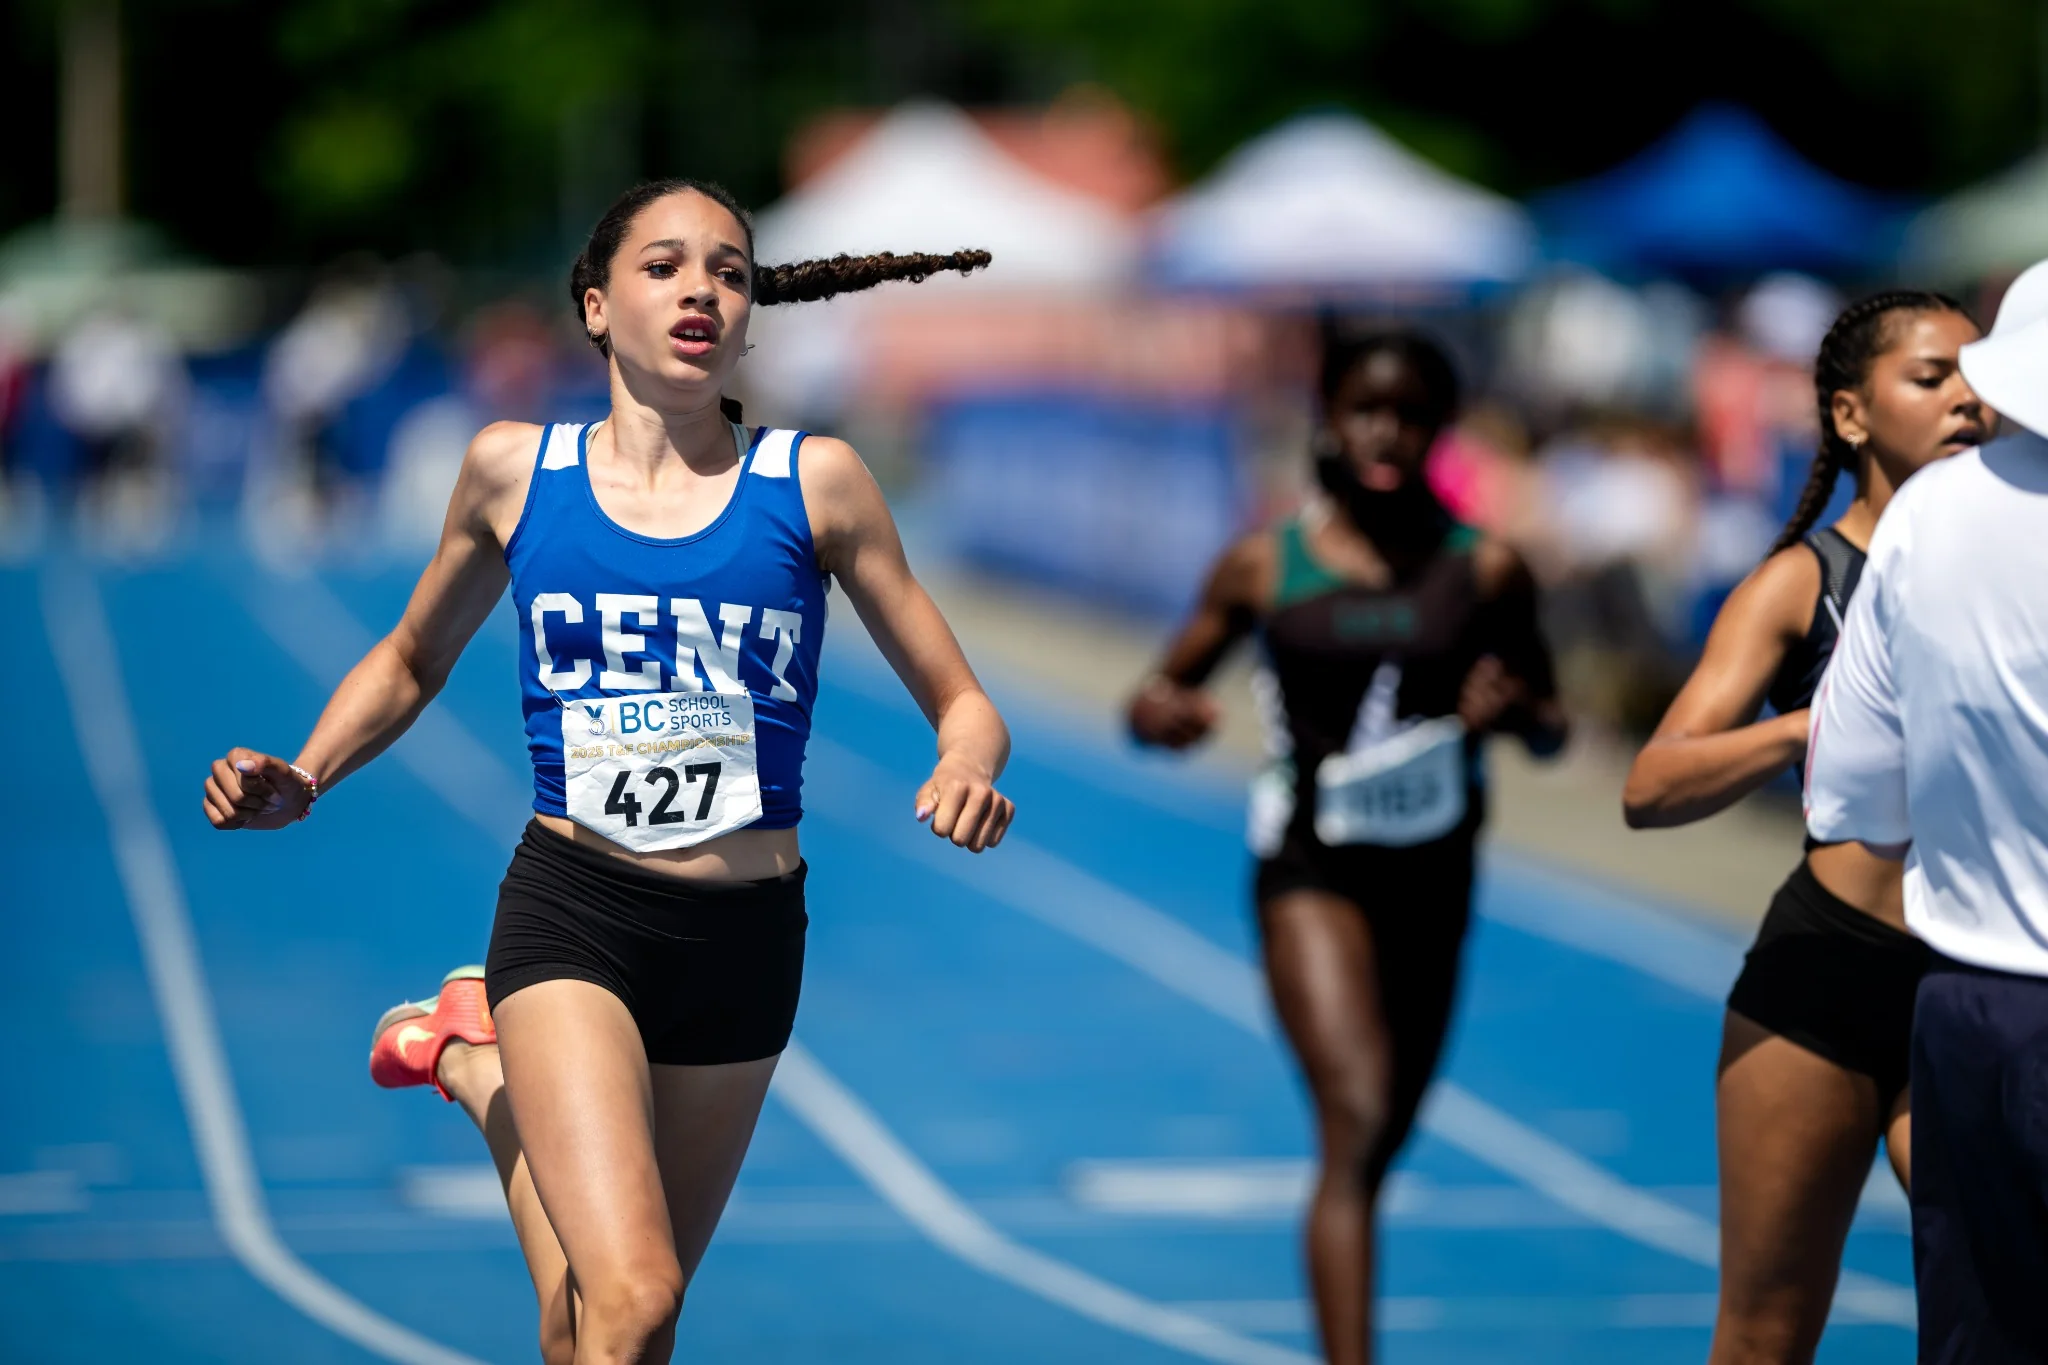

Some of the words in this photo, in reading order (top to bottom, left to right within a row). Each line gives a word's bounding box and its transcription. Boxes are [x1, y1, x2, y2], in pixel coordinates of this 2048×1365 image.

[531, 592, 802, 702] CENT
[669, 696, 730, 713] SCHOOL
[619, 701, 665, 734] BC
[670, 712, 732, 730] SPORTS
[570, 746, 605, 760] 2025
[608, 743, 634, 757] T&F
[604, 761, 722, 827] 427
